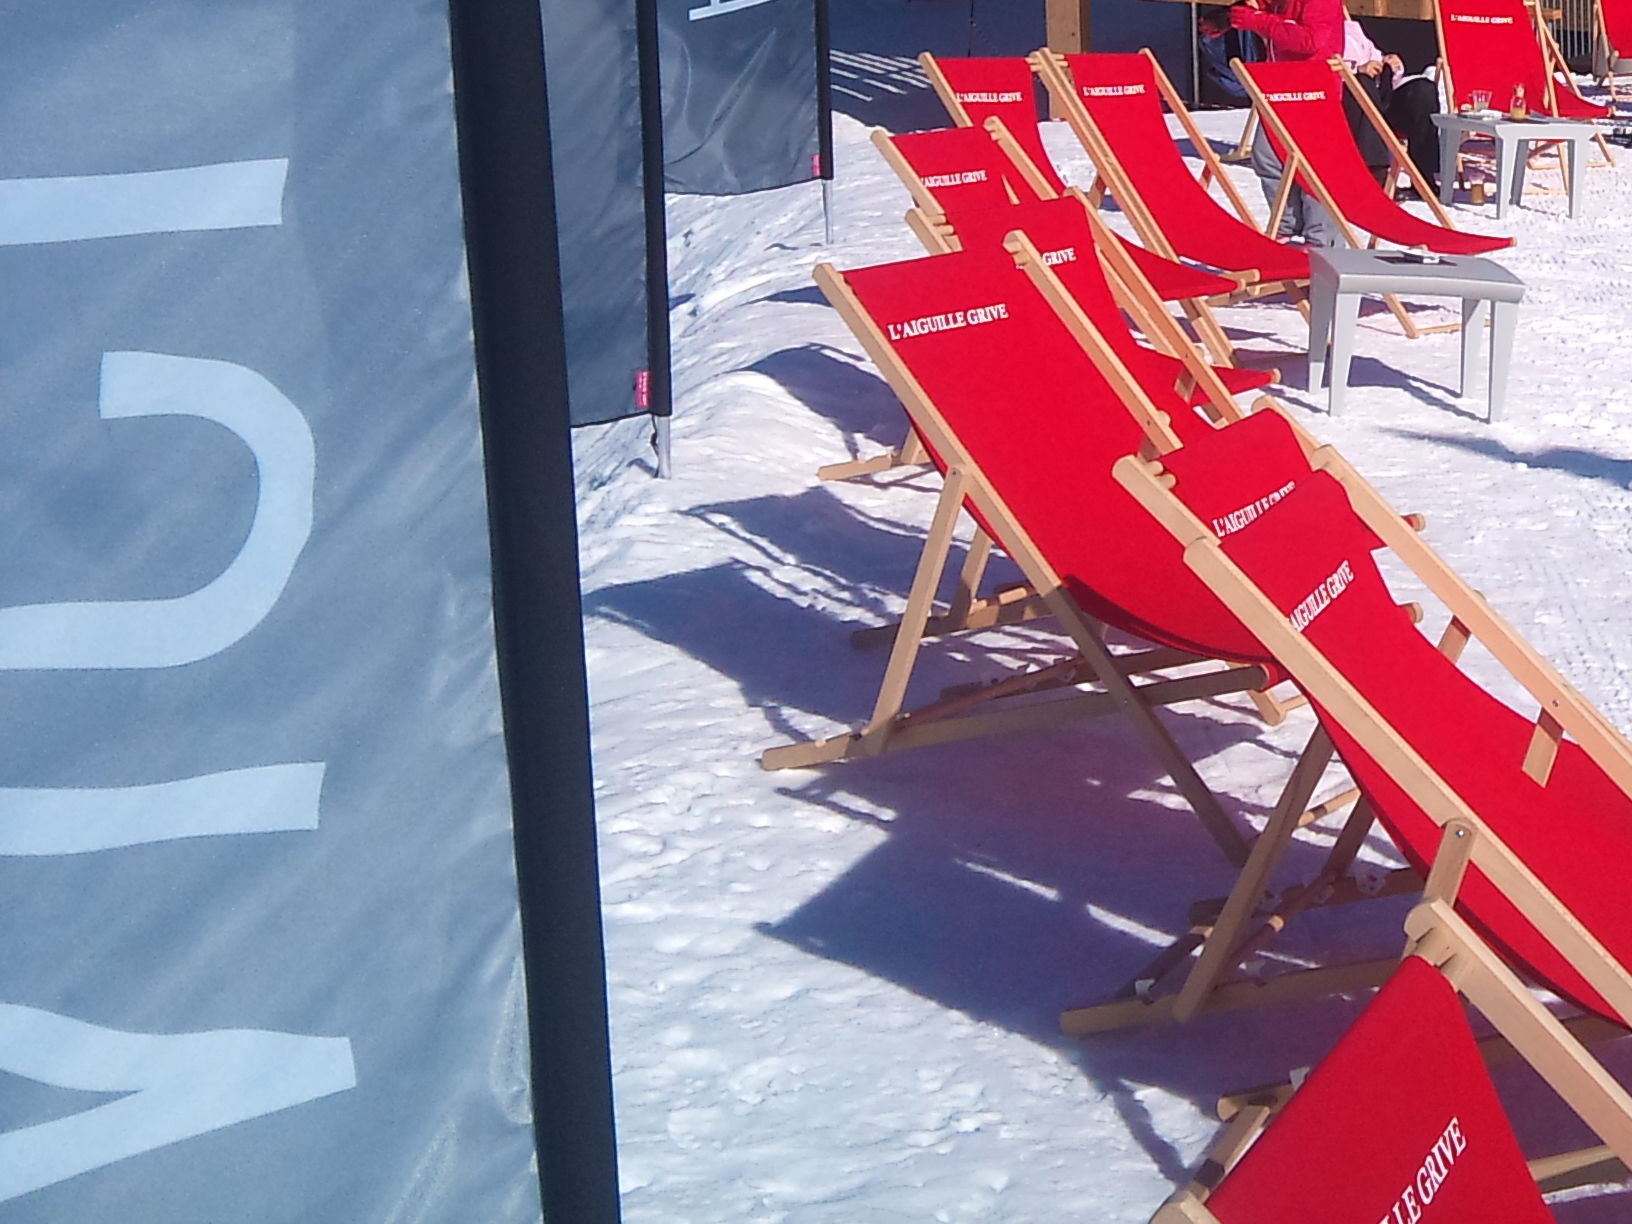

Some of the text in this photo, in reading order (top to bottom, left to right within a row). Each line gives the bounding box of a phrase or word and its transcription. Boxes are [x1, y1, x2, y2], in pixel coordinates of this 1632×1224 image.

[887, 303, 1009, 341] L'AIGUILLE GRIVE
[1325, 559, 1355, 600] GRIVE
[1416, 1116, 1467, 1205] GRIVE
